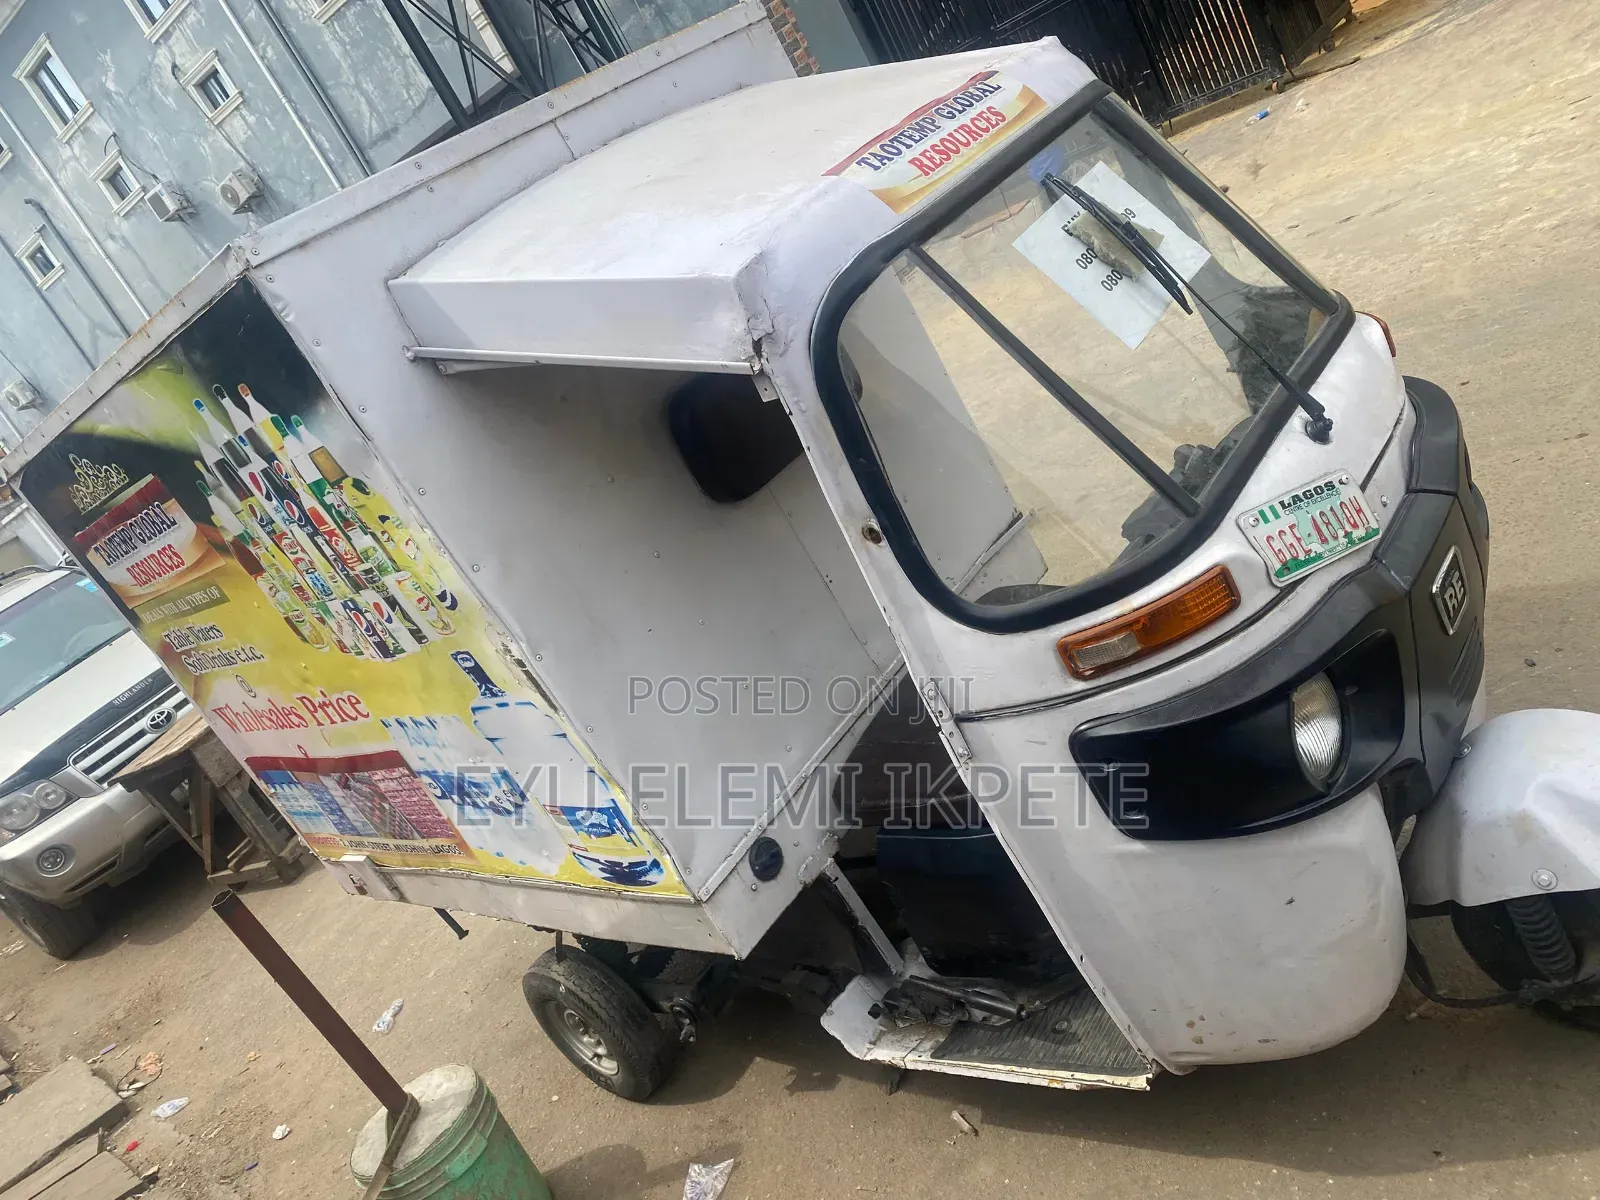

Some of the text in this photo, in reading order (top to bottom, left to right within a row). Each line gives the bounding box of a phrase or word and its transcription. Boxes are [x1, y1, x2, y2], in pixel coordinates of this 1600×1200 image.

[856, 80, 1003, 171] TAOTEMP GLOBAL
[908, 106, 1007, 176] RESOURCES
[1278, 480, 1336, 510] LAGOS
[93, 502, 178, 566] TAOTEMP GLOBAL
[126, 544, 186, 587] RESOURCES
[141, 585, 221, 623] DEALS WITH ALL TYPES OF
[1444, 570, 1464, 619] RE
[164, 624, 224, 650] Table Waters
[183, 650, 208, 674] Soft
[205, 648, 238, 669] Drinks
[112, 677, 153, 706] HIGHLANDER
[212, 690, 370, 735] Wholesales Price
